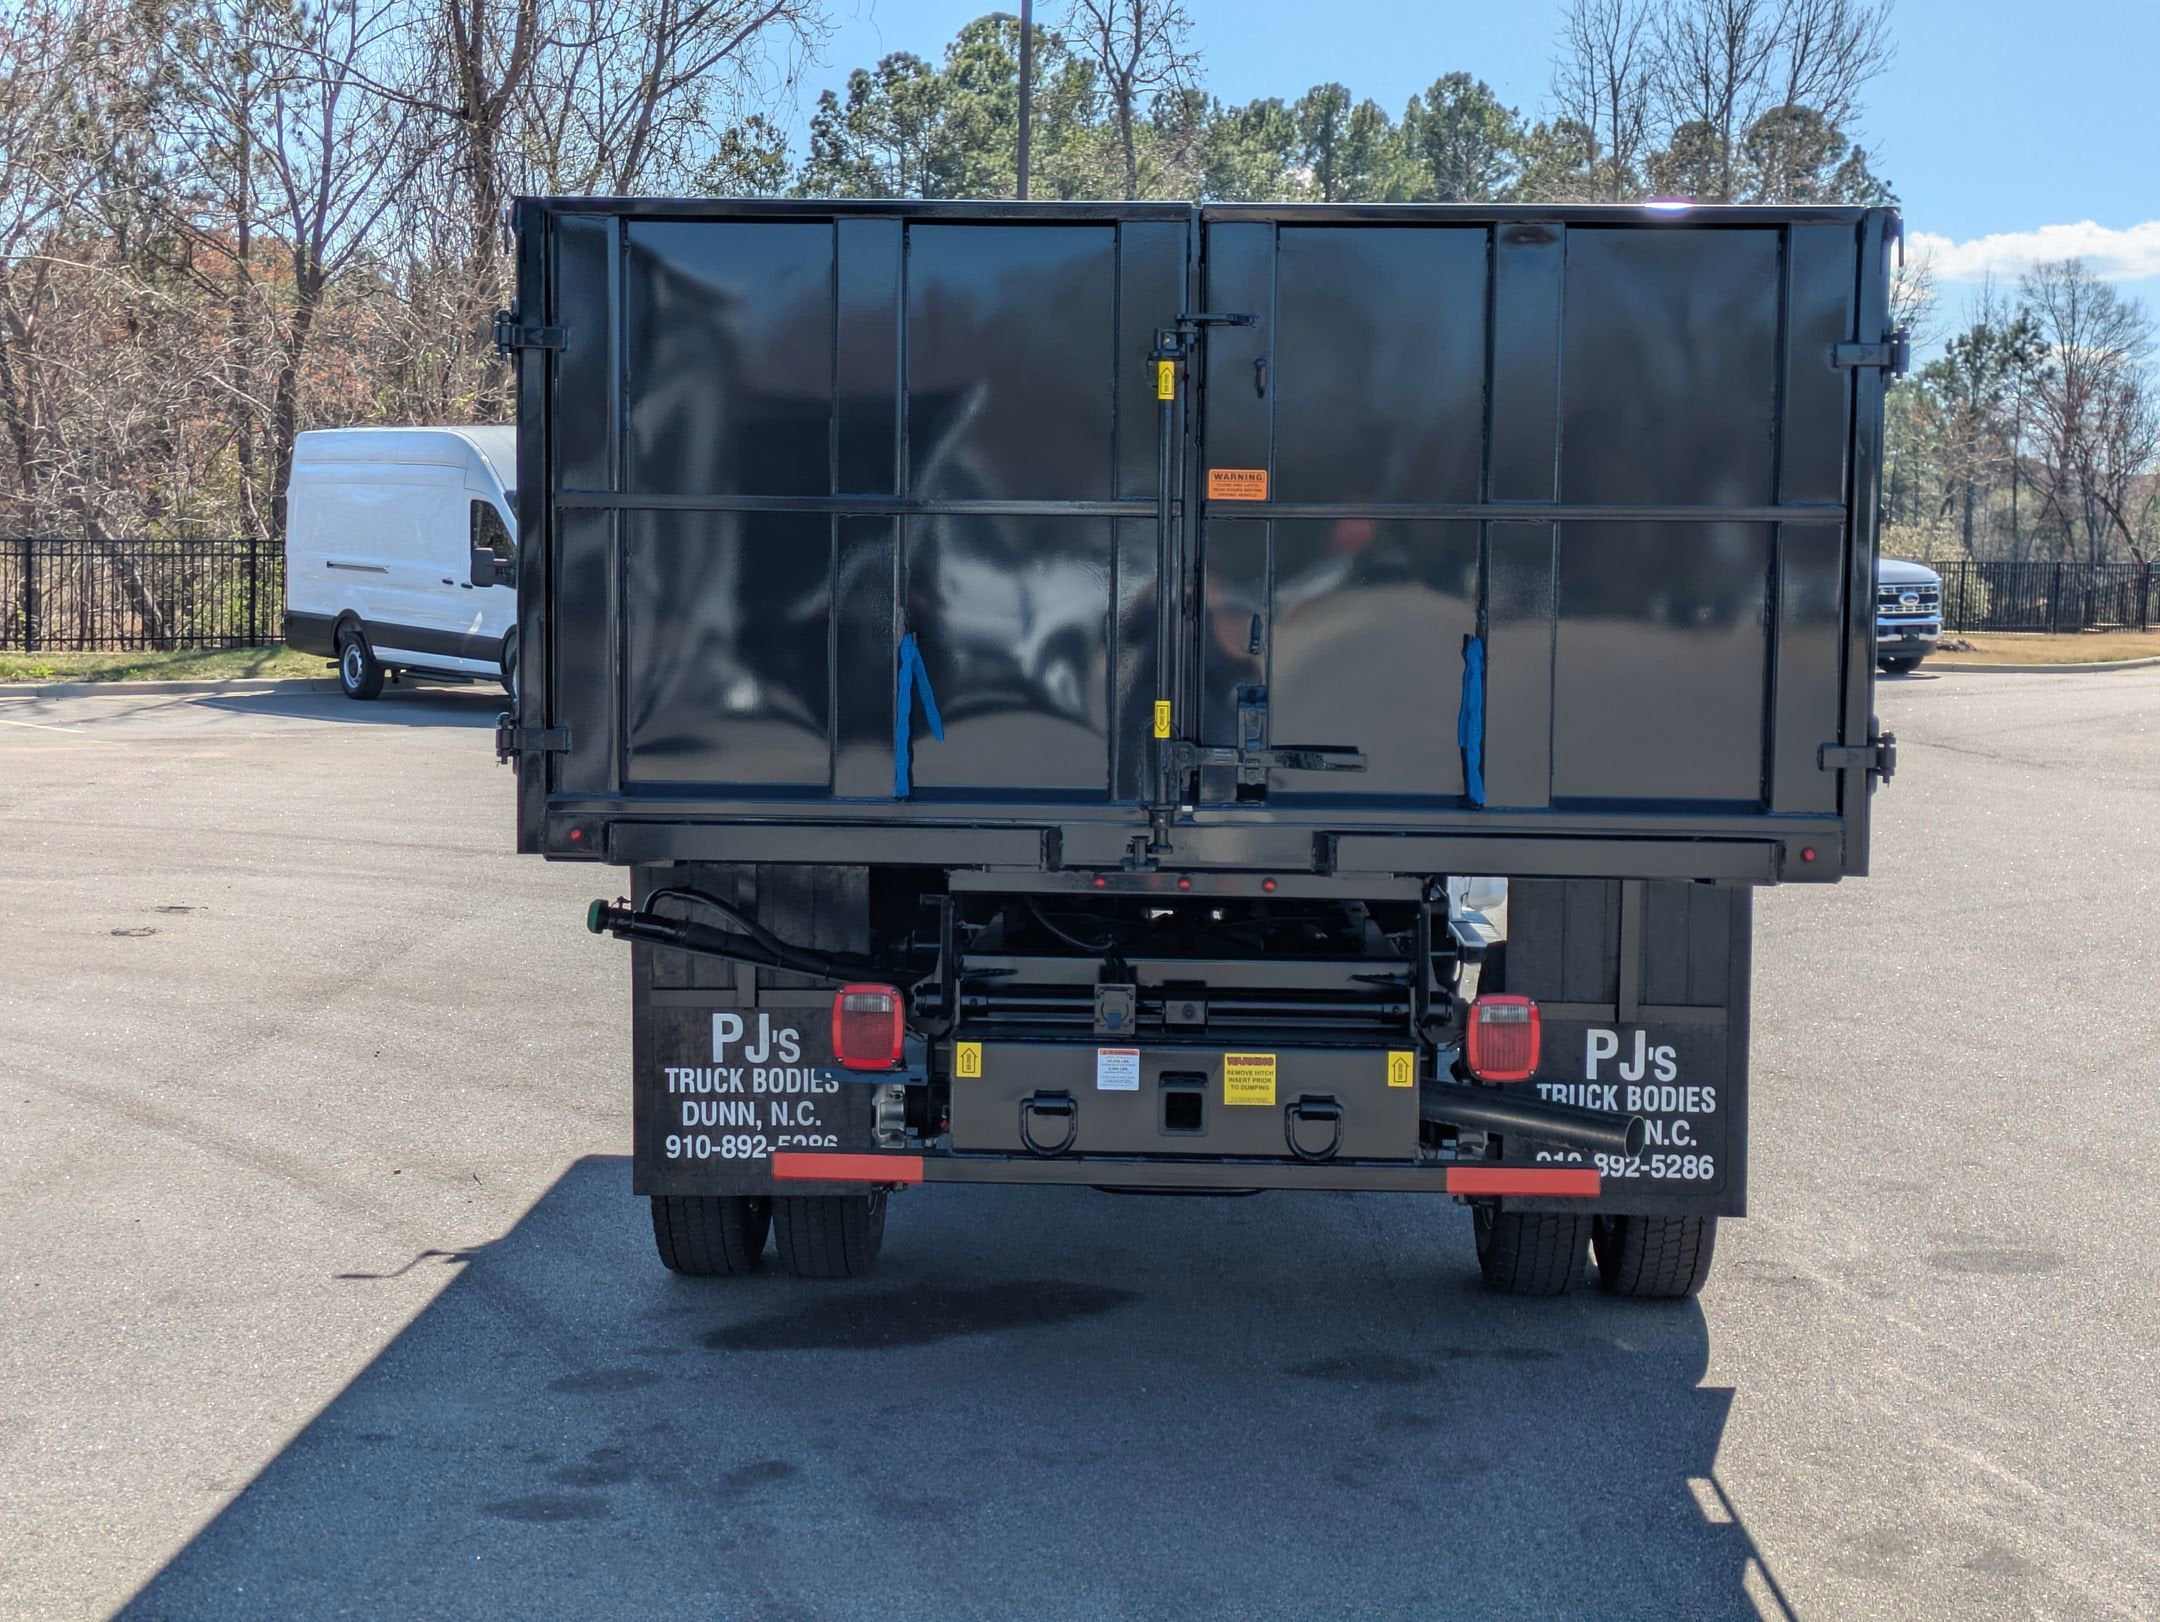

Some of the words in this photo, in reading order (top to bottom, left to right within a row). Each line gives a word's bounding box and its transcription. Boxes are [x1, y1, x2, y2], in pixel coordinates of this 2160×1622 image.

[1214, 473, 1263, 481] WARNING
[1226, 1056, 1274, 1067] WARNING
[664, 1067, 745, 1094] TRUCK
[753, 1067, 840, 1094] BODIES
[1536, 1083, 1619, 1111] TRUCK
[1627, 1085, 1717, 1114] BODIES
[682, 1101, 763, 1131] DUNN,
[771, 1101, 822, 1126] N.C.
[1644, 1119, 1697, 1146] N.C.
[1536, 1151, 1715, 1180] 892-5286
